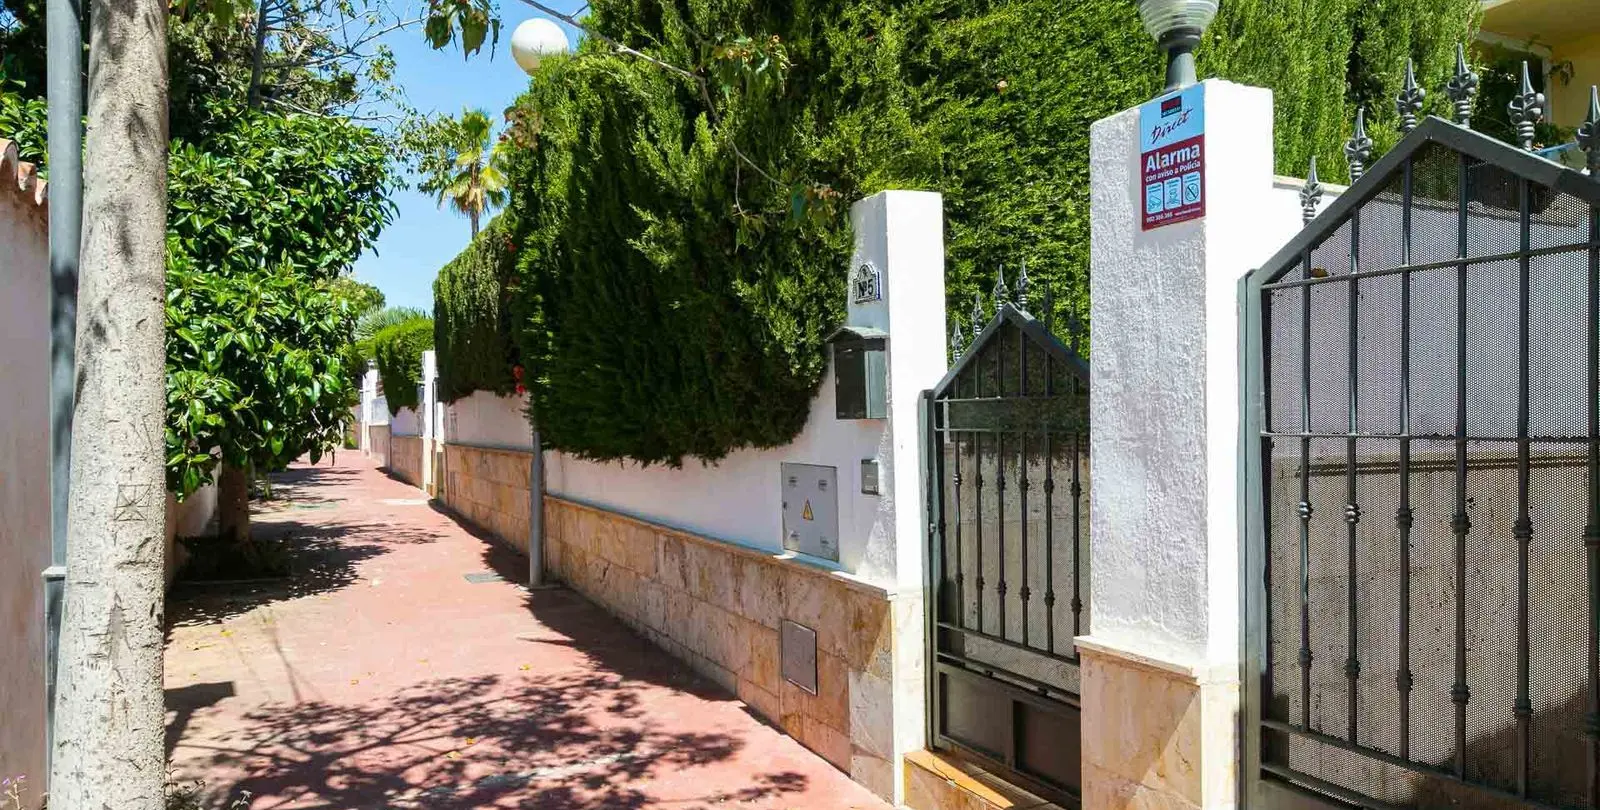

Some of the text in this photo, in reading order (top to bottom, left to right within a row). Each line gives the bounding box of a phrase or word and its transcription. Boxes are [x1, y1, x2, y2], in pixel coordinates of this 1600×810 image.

[1146, 144, 1201, 173] Alarma
[1146, 174, 1156, 183] con
[1157, 169, 1174, 179] aviso
[1179, 160, 1201, 173] Policía
